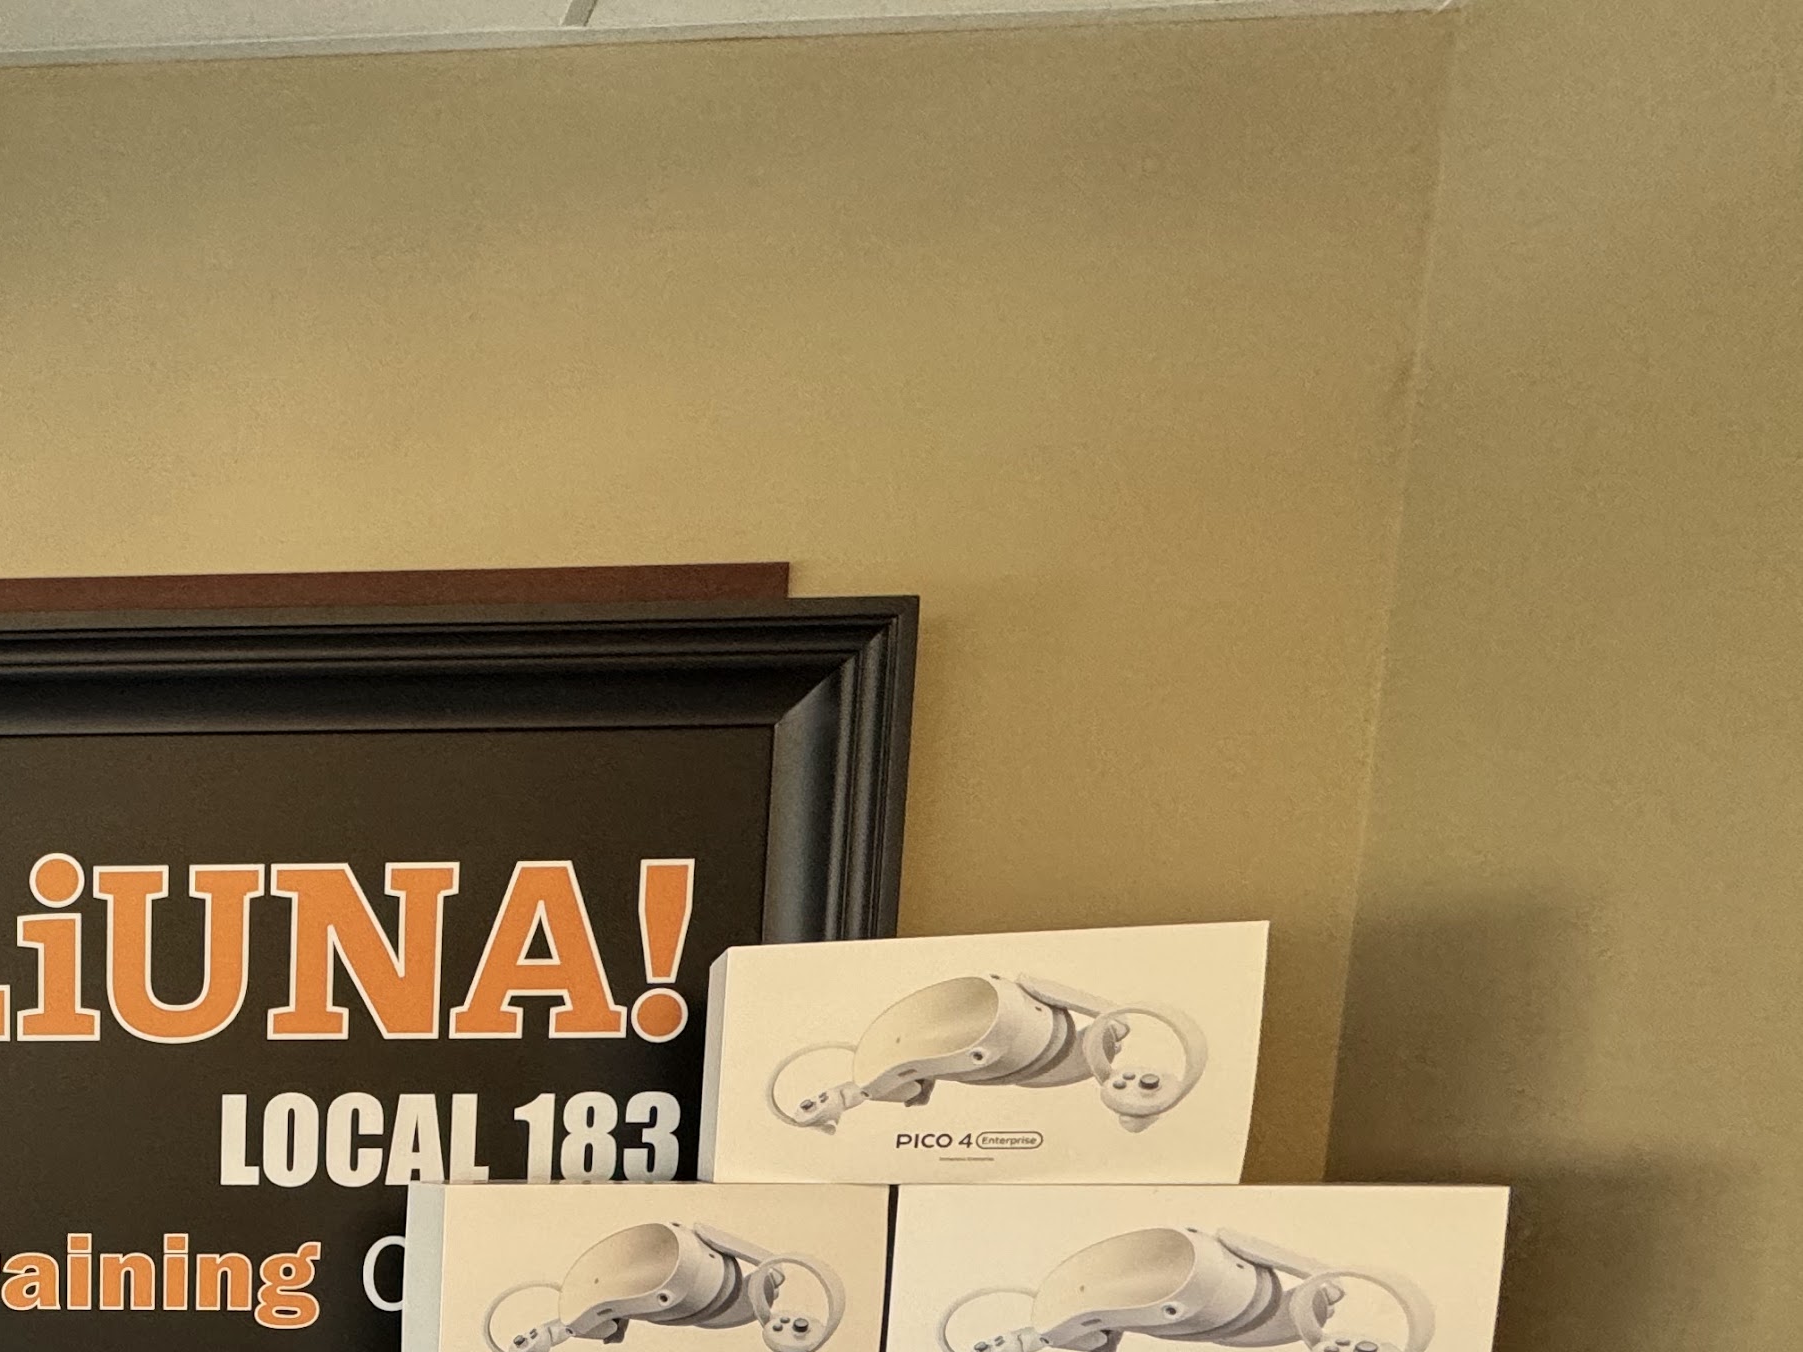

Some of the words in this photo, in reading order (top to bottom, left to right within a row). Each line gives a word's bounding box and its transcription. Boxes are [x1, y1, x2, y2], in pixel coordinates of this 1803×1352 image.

[220, 1093, 489, 1186] LOCAL
[514, 1091, 681, 1181] 183
[895, 1133, 953, 1149] PICO
[958, 1133, 973, 1149] 4
[981, 1136, 1037, 1146] Enterprise
